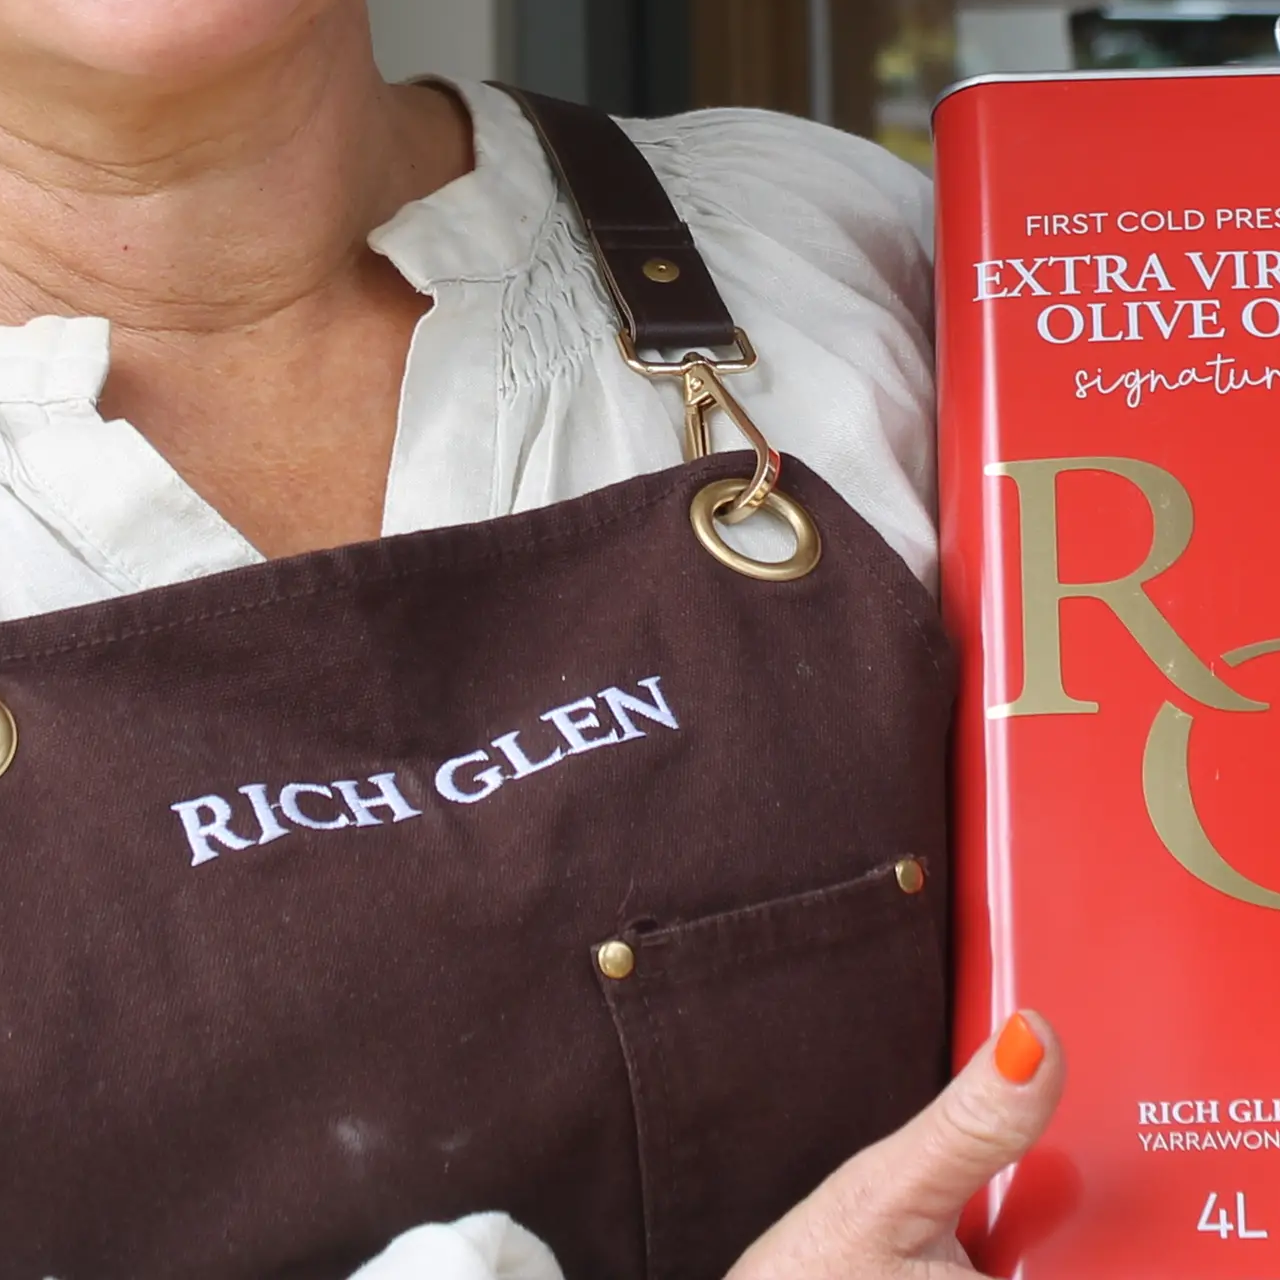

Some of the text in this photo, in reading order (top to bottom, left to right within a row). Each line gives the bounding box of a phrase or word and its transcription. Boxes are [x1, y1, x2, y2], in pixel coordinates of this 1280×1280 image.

[1026, 212, 1109, 236] FIRST
[1117, 208, 1206, 233] COLD
[972, 251, 1176, 302] EXTRA
[1036, 298, 1226, 344] OLIVE
[171, 675, 680, 866] RICH GLEN
[1137, 1100, 1220, 1126] RICH
[1196, 1191, 1269, 1240] 4L
